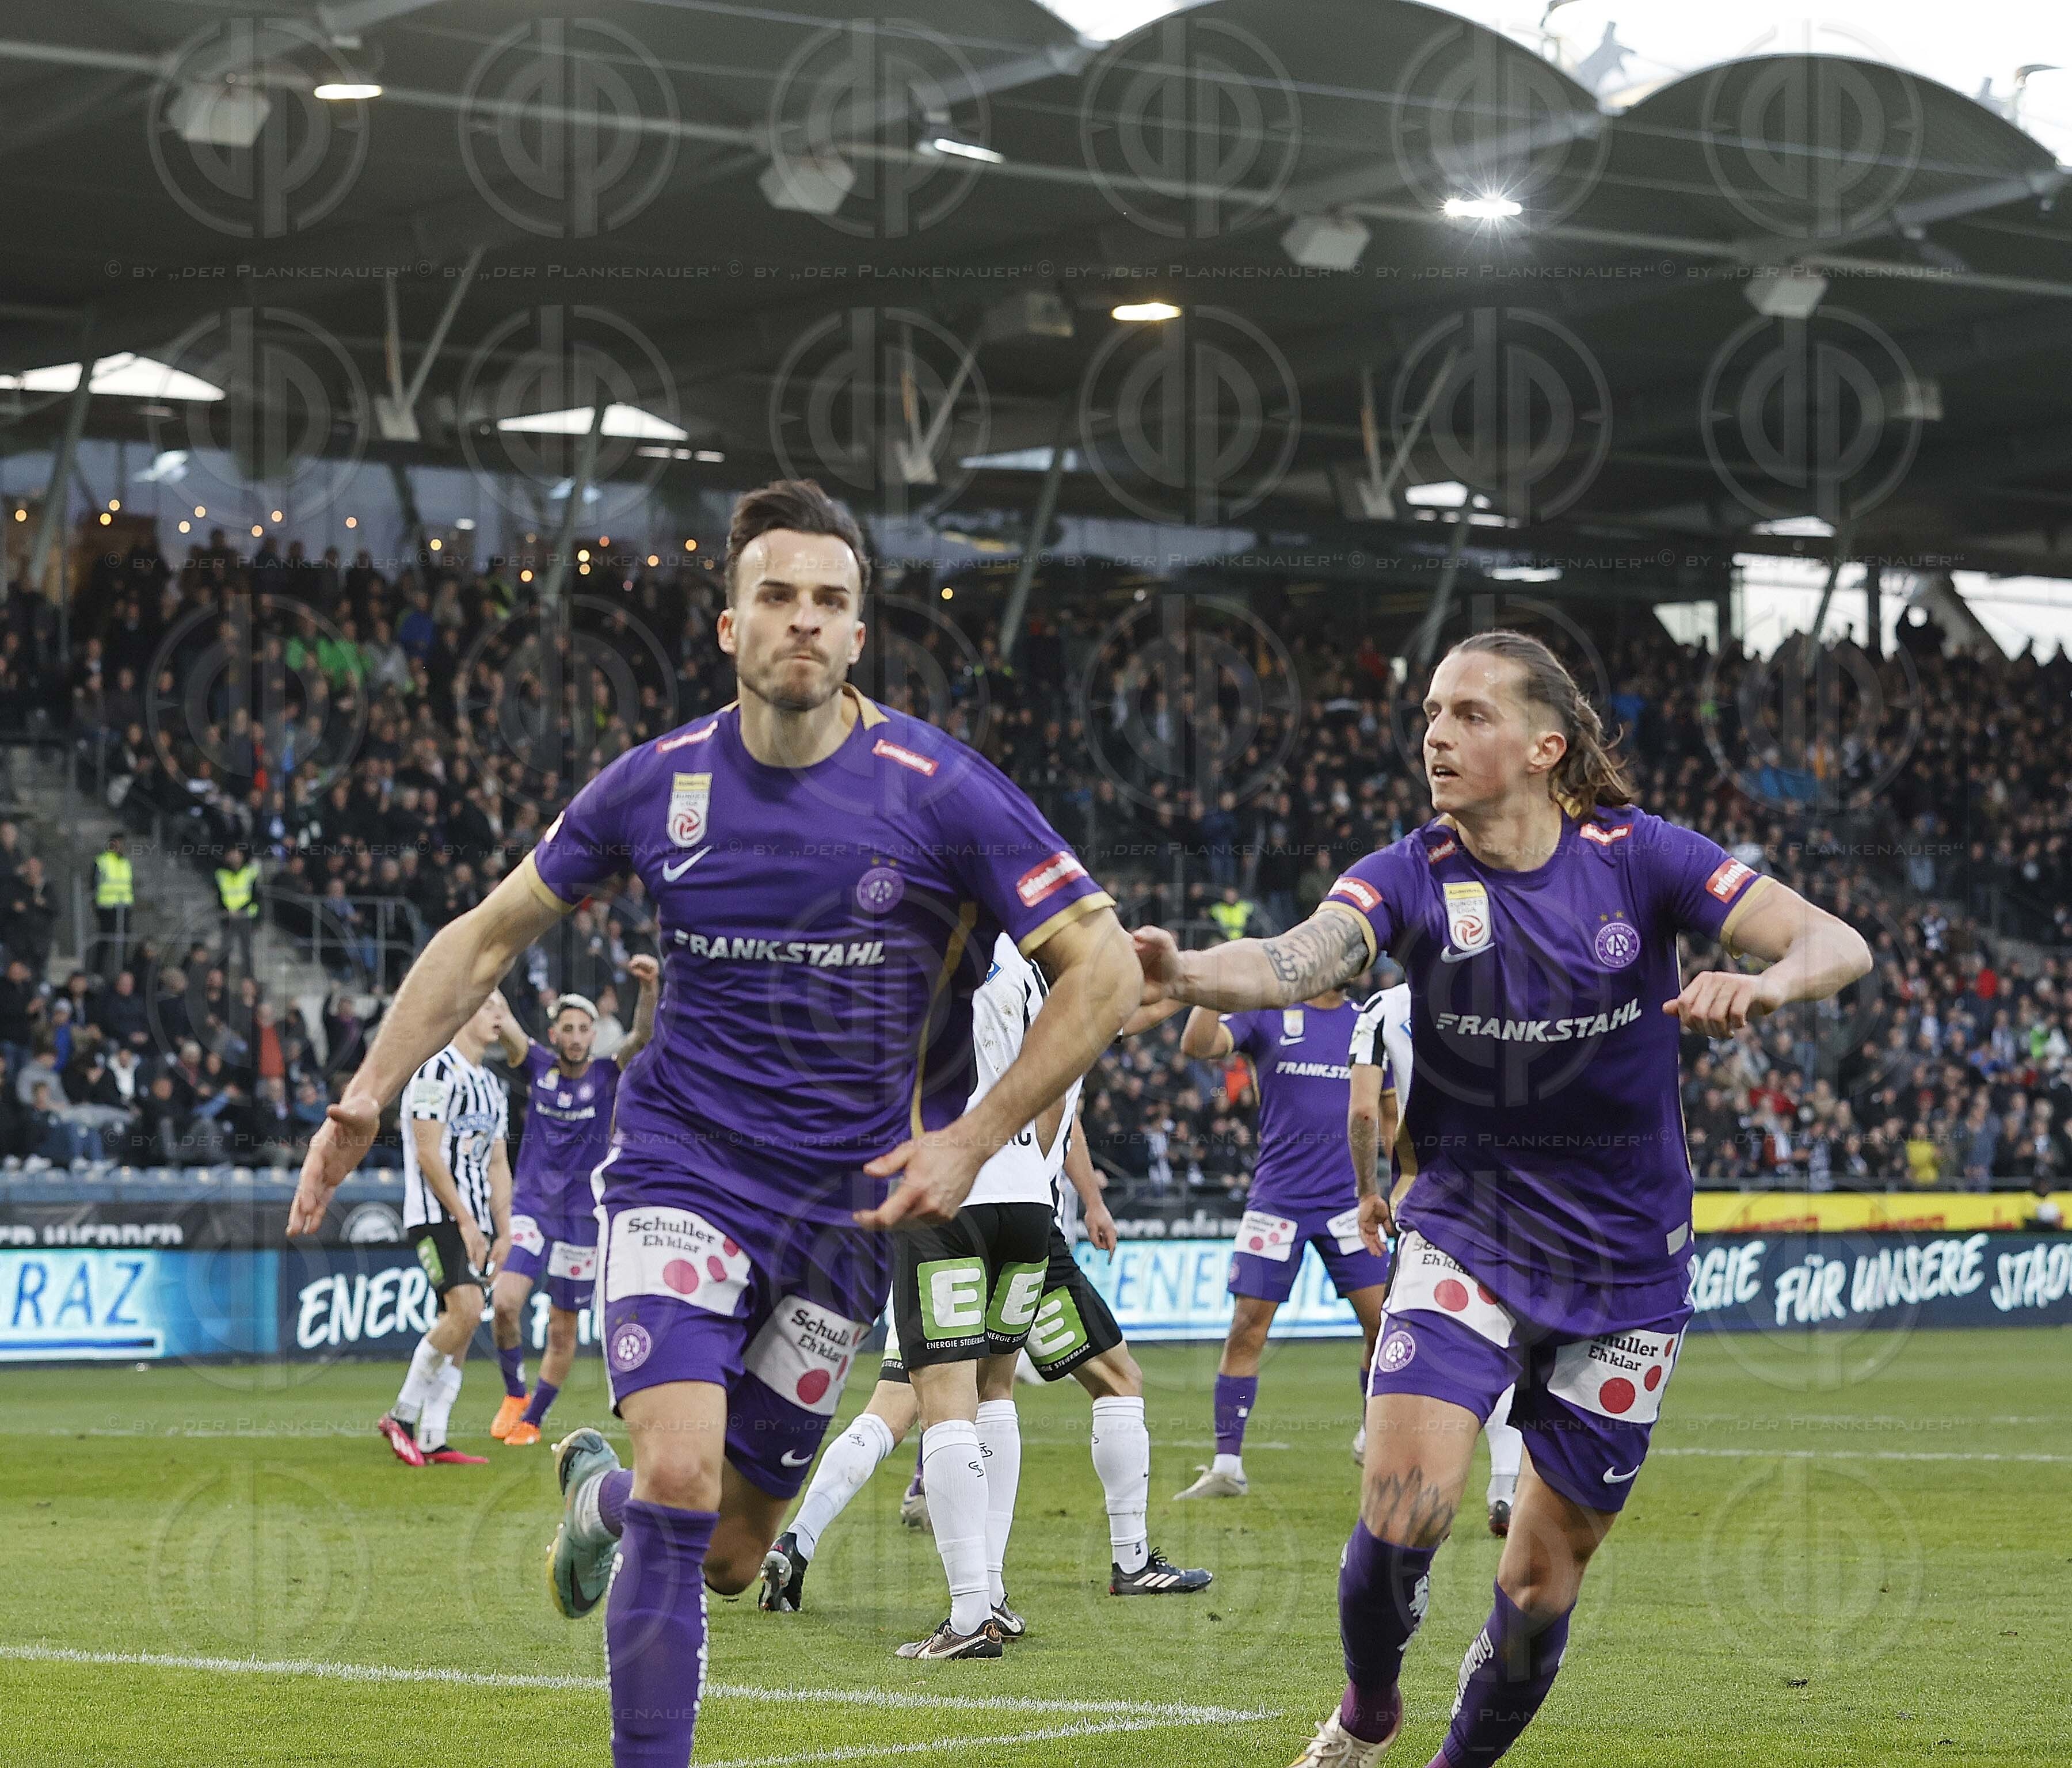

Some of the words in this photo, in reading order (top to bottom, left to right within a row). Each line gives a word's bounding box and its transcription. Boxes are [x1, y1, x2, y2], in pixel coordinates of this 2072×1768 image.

[627, 1216, 716, 1244] Schuller
[931, 1268, 982, 1328] E
[1000, 1268, 1045, 1325] E
[1776, 1253, 1847, 1326] FÜR
[1850, 1232, 1989, 1313] UNSERE
[1990, 1242, 2072, 1313] STAD
[926, 1339, 958, 1350] ENERGIE
